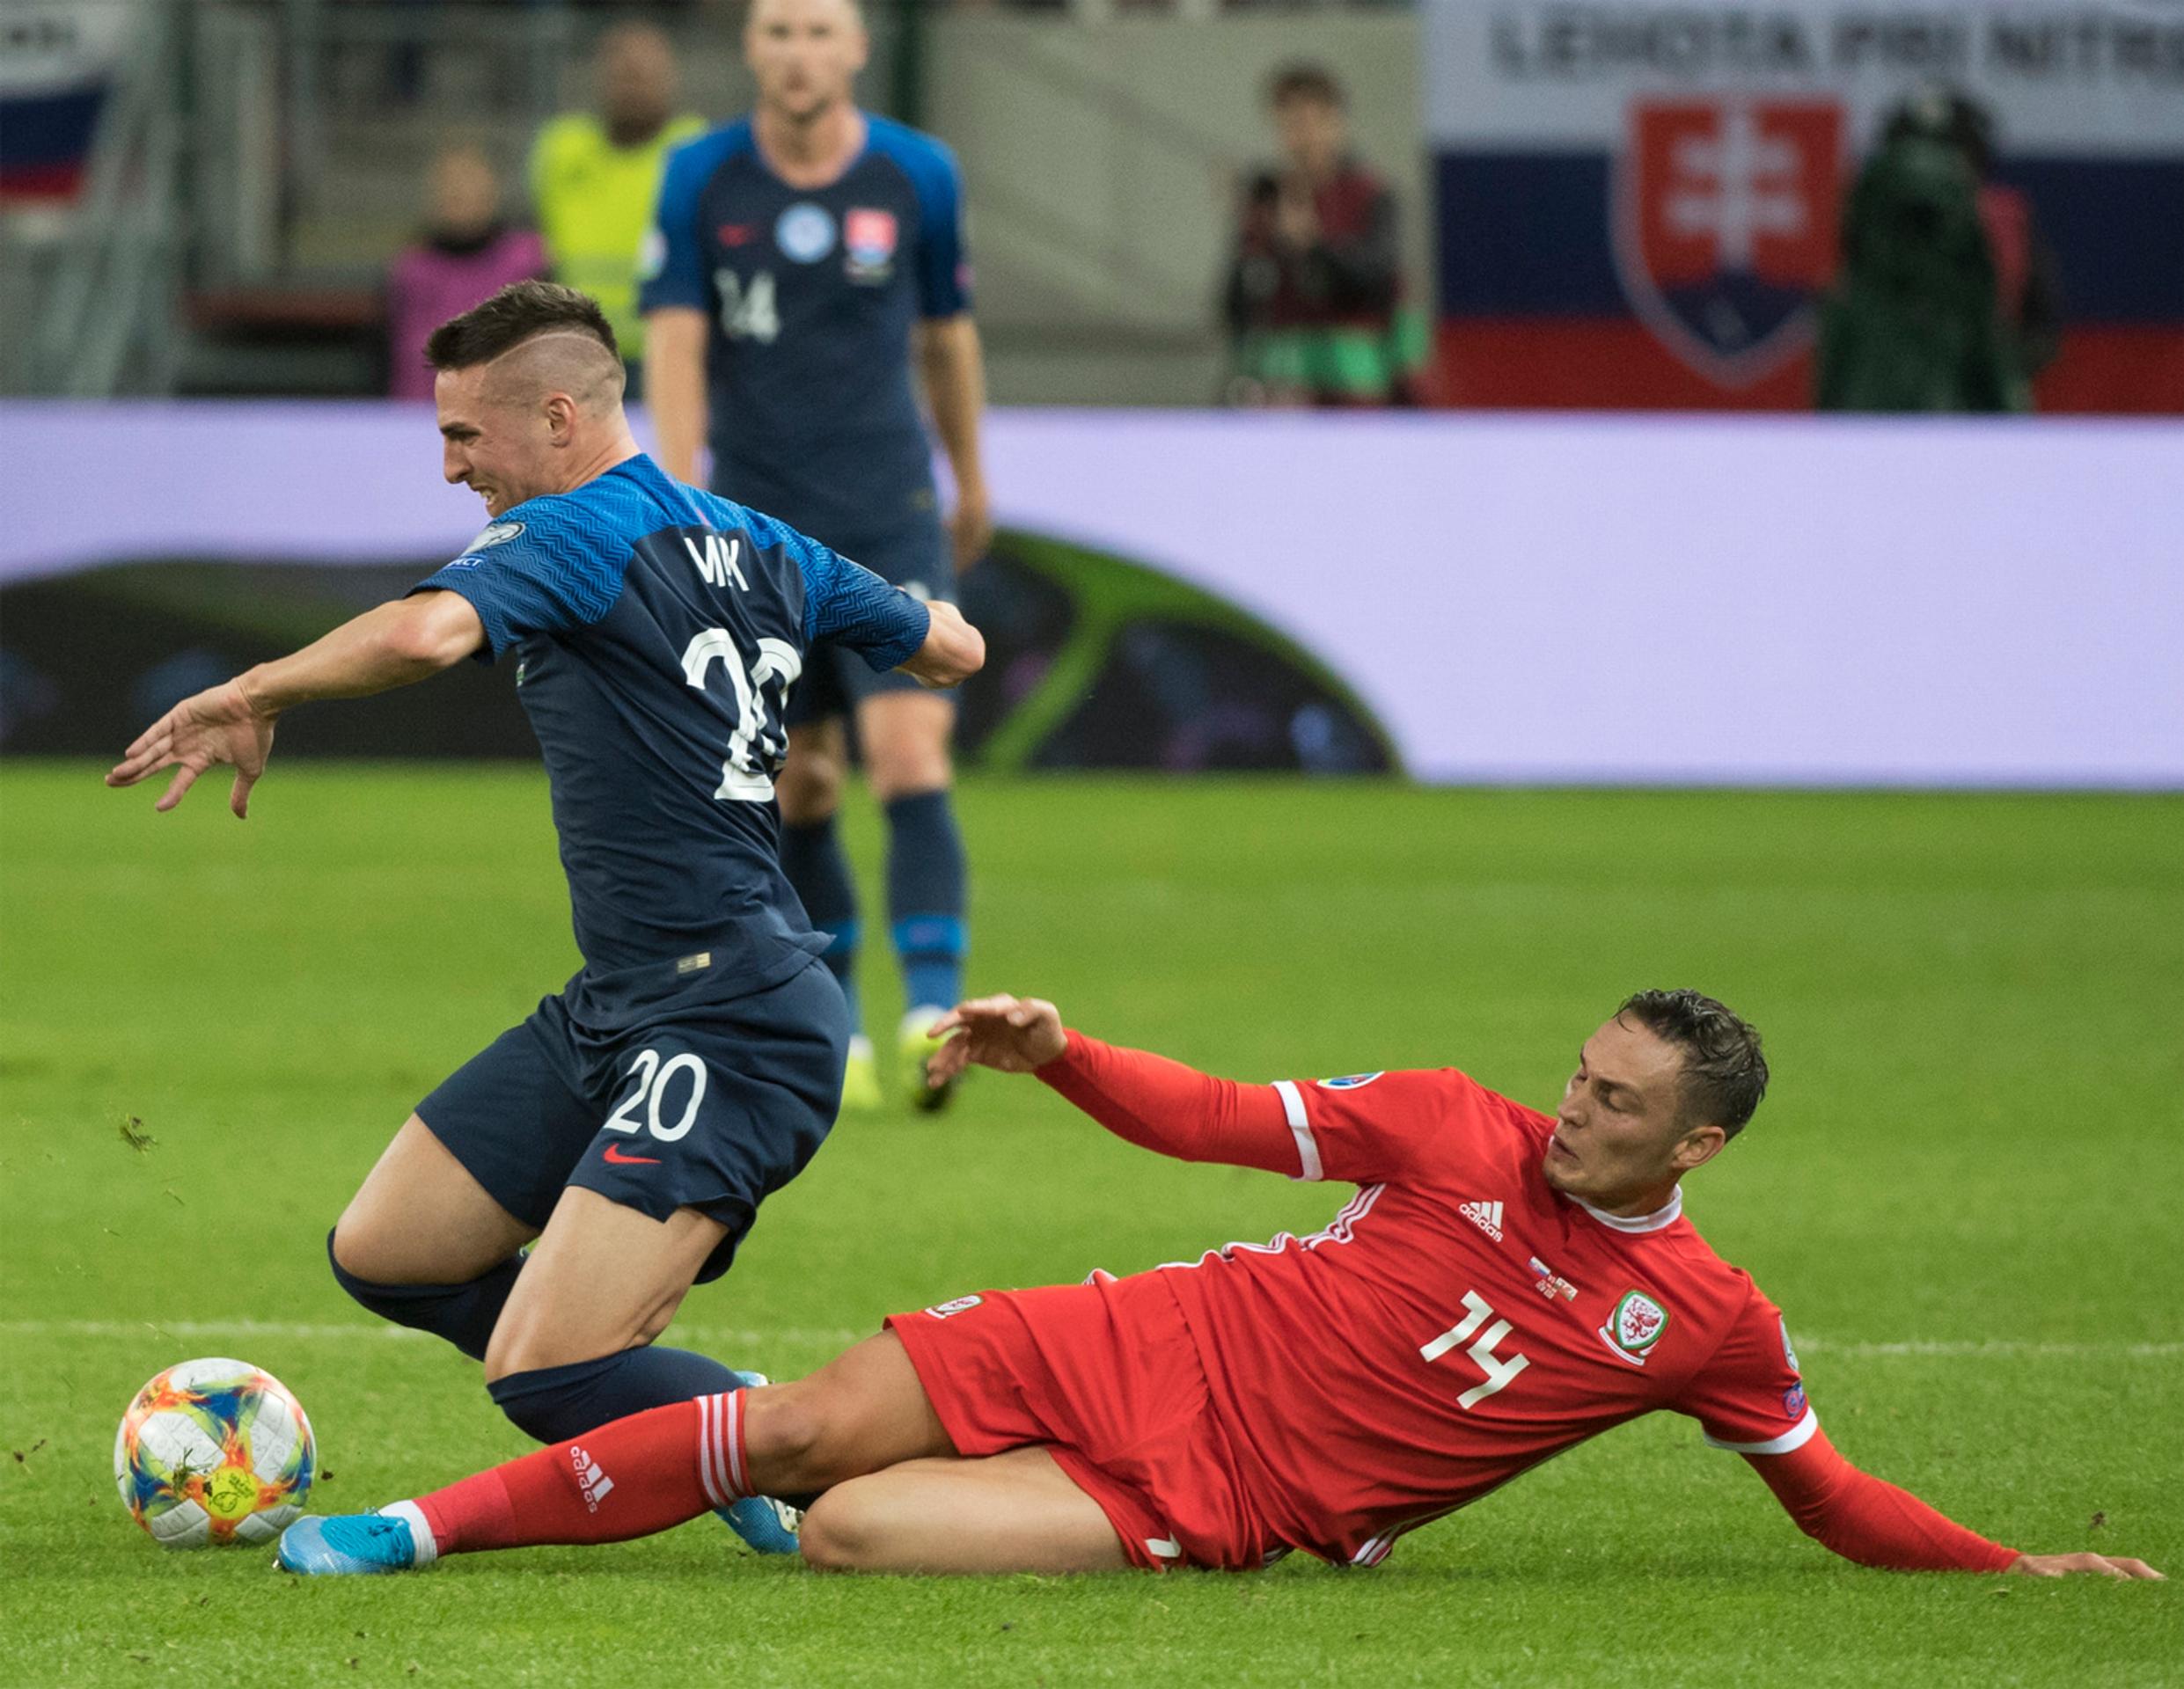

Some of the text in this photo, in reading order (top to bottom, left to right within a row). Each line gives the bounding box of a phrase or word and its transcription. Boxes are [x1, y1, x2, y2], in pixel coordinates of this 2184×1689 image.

[1489, 12, 1813, 77] LEHOTA
[713, 267, 779, 342] 14
[680, 627, 803, 802] 20
[603, 1049, 708, 1143] 20
[1458, 1203, 1504, 1243] adidas
[1418, 1289, 1531, 1410] 14
[570, 1445, 597, 1513] adidas
